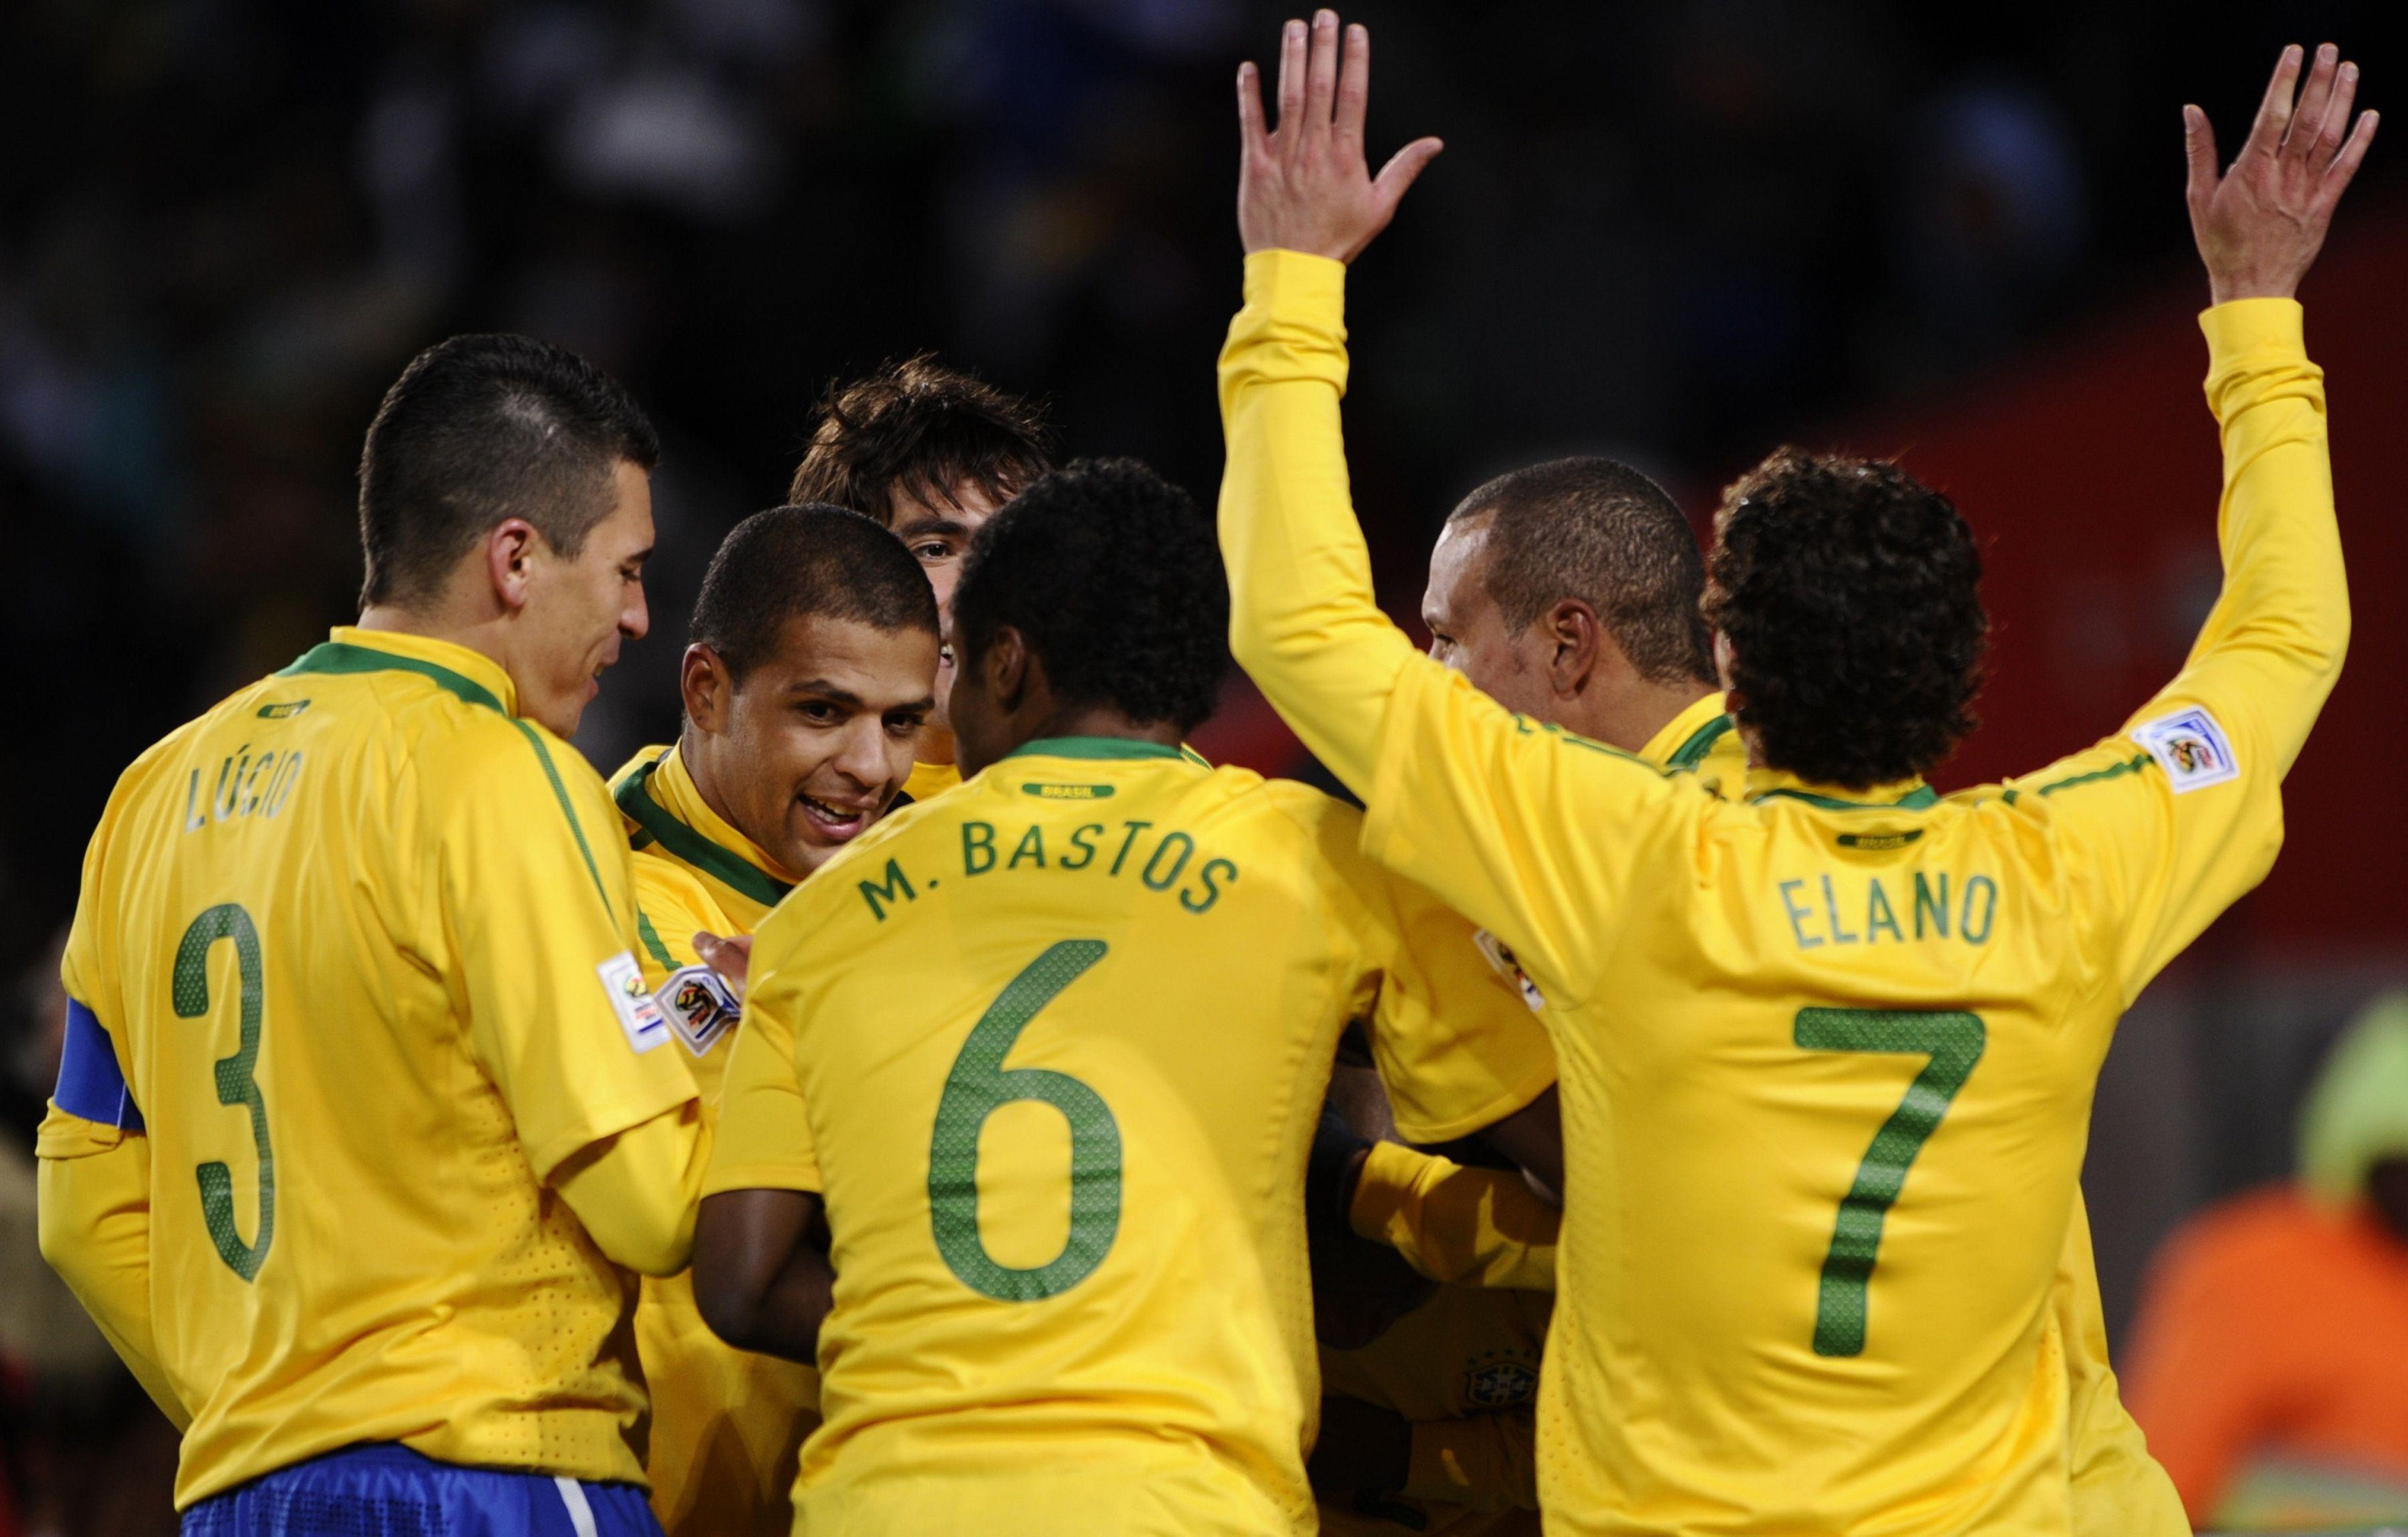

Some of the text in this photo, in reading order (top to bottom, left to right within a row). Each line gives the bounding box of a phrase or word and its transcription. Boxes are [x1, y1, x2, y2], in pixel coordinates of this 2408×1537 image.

[186, 744, 302, 833] LÚCIO
[858, 821, 1238, 921] M. BASTOS
[1779, 871, 1997, 950] ELANO
[172, 903, 275, 1284] 3
[929, 939, 1123, 1302] 6
[1794, 1007, 1987, 1358] 7
